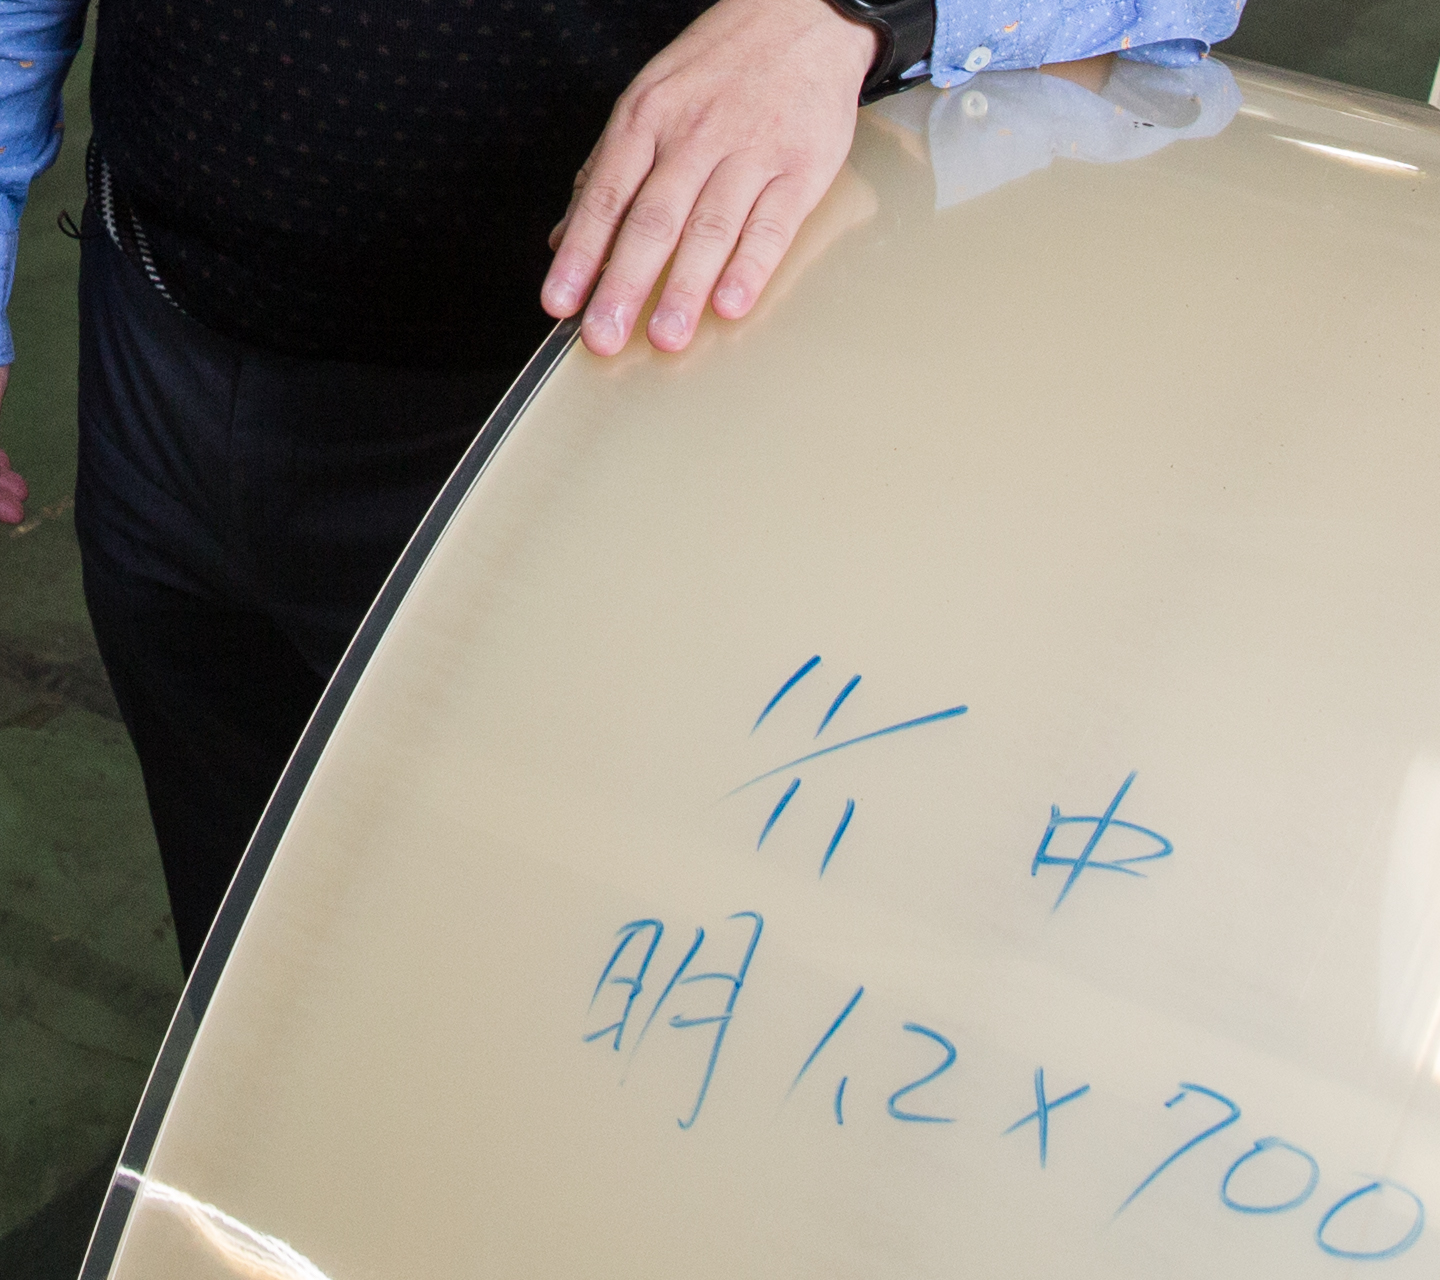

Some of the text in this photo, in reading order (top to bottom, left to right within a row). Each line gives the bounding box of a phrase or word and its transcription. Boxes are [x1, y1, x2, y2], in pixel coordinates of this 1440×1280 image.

[726, 654, 1173, 912] 11/11 中
[583, 911, 764, 1130] 明
[1114, 1082, 1425, 1261] 700
